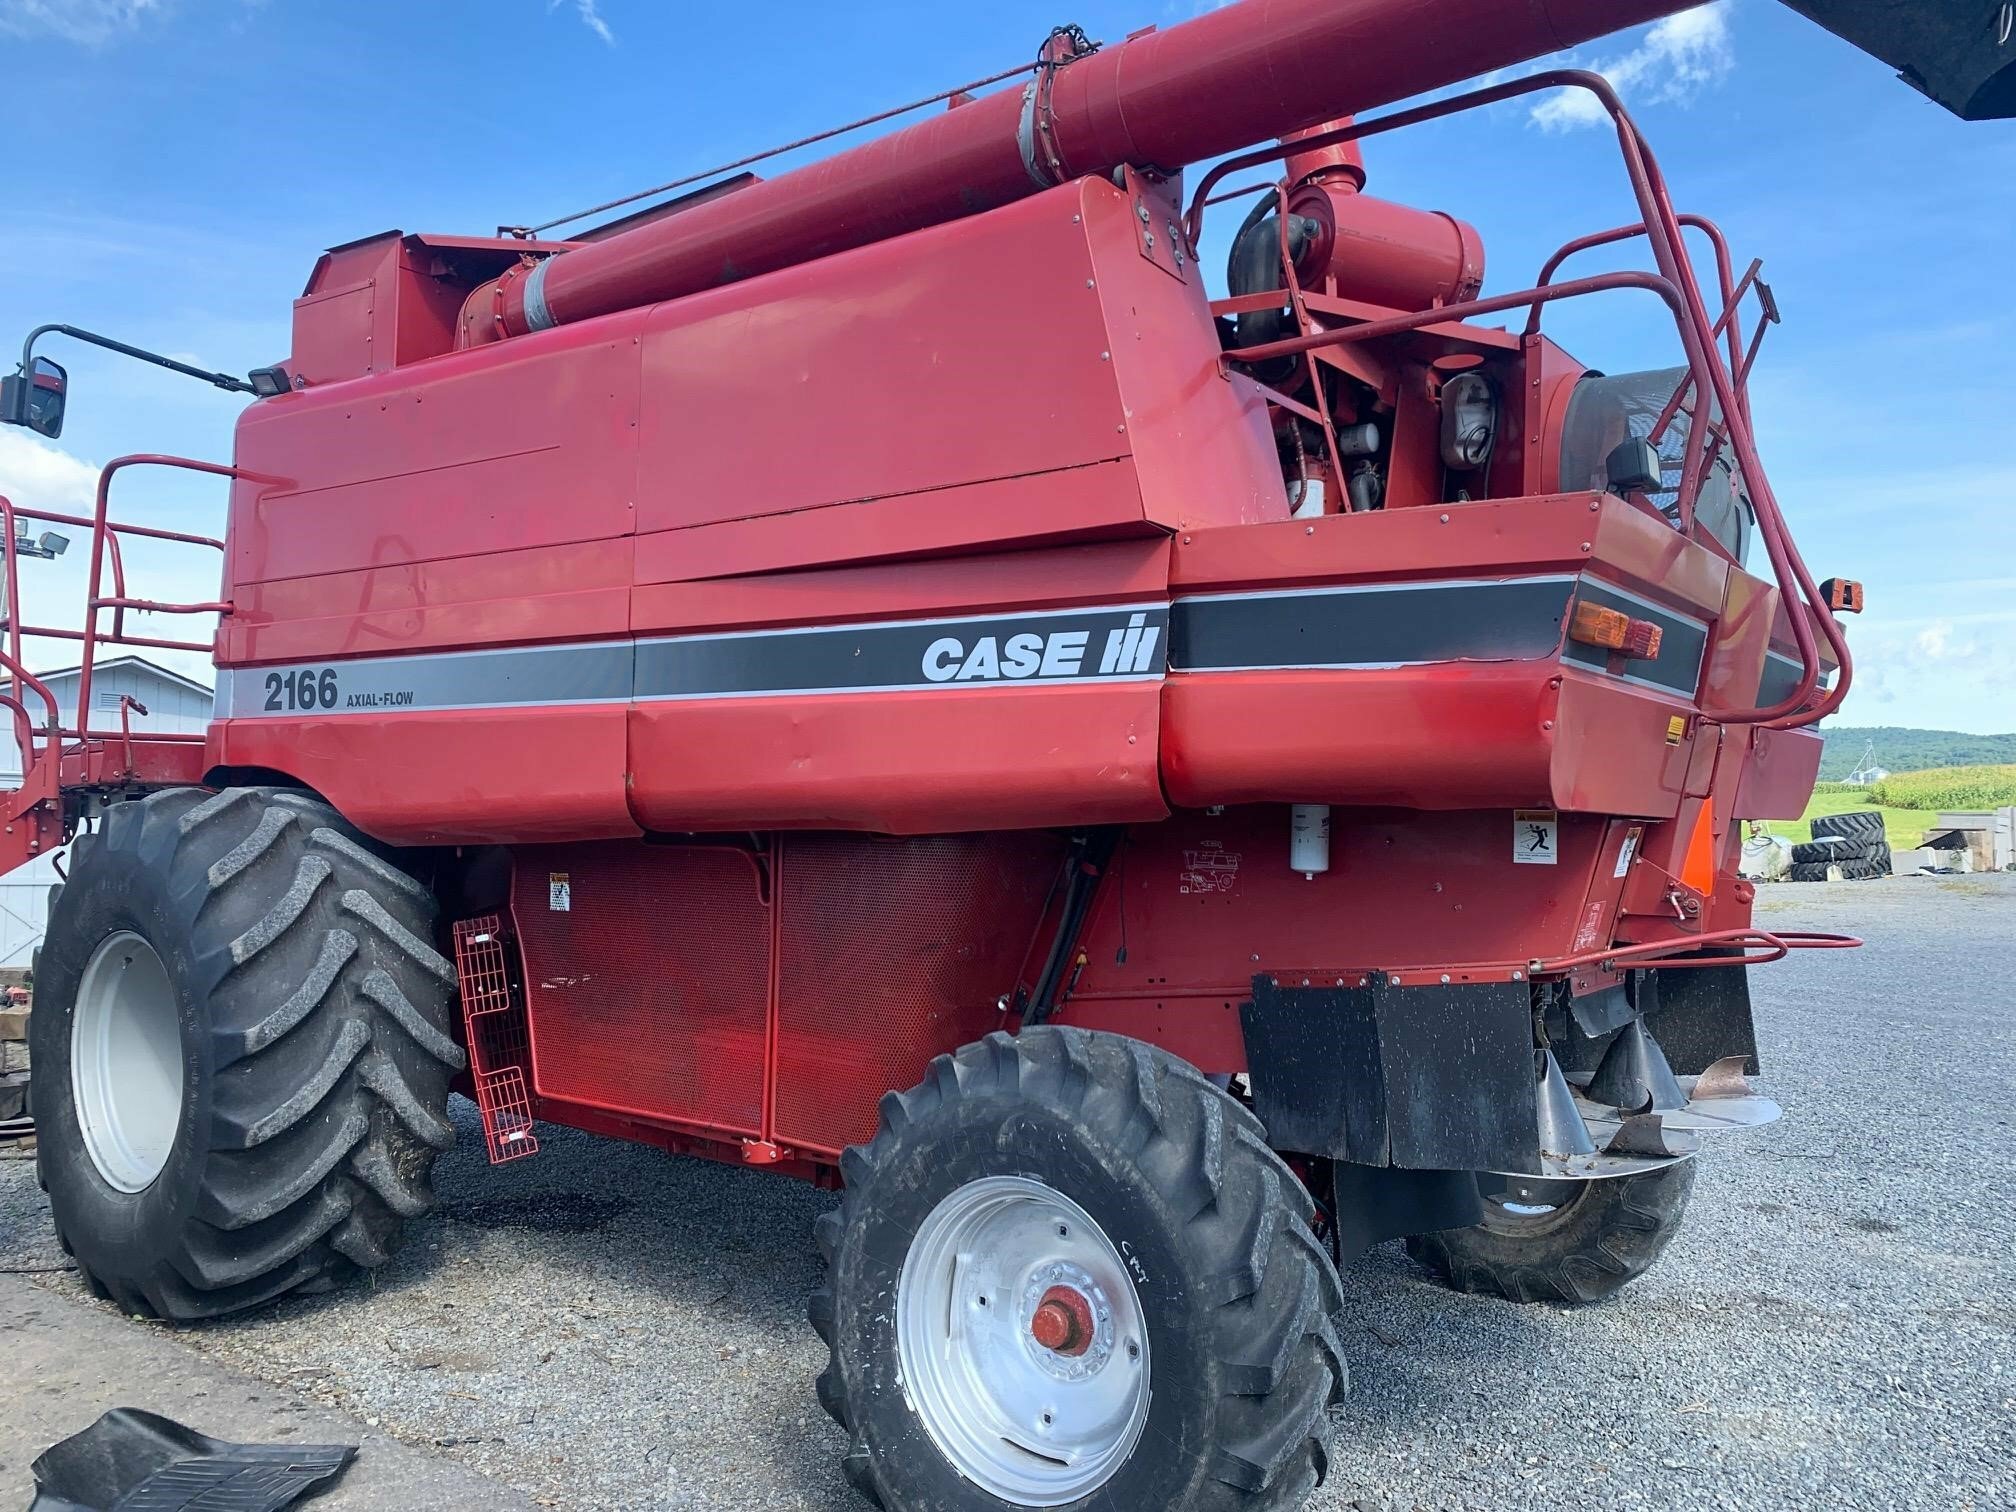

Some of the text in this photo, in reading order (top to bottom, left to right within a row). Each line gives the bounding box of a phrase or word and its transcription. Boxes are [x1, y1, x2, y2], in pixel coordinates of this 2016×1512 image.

[921, 630, 1090, 682] CASE
[264, 668, 338, 711] 2166
[346, 692, 414, 708] AXIAL-FLOW
